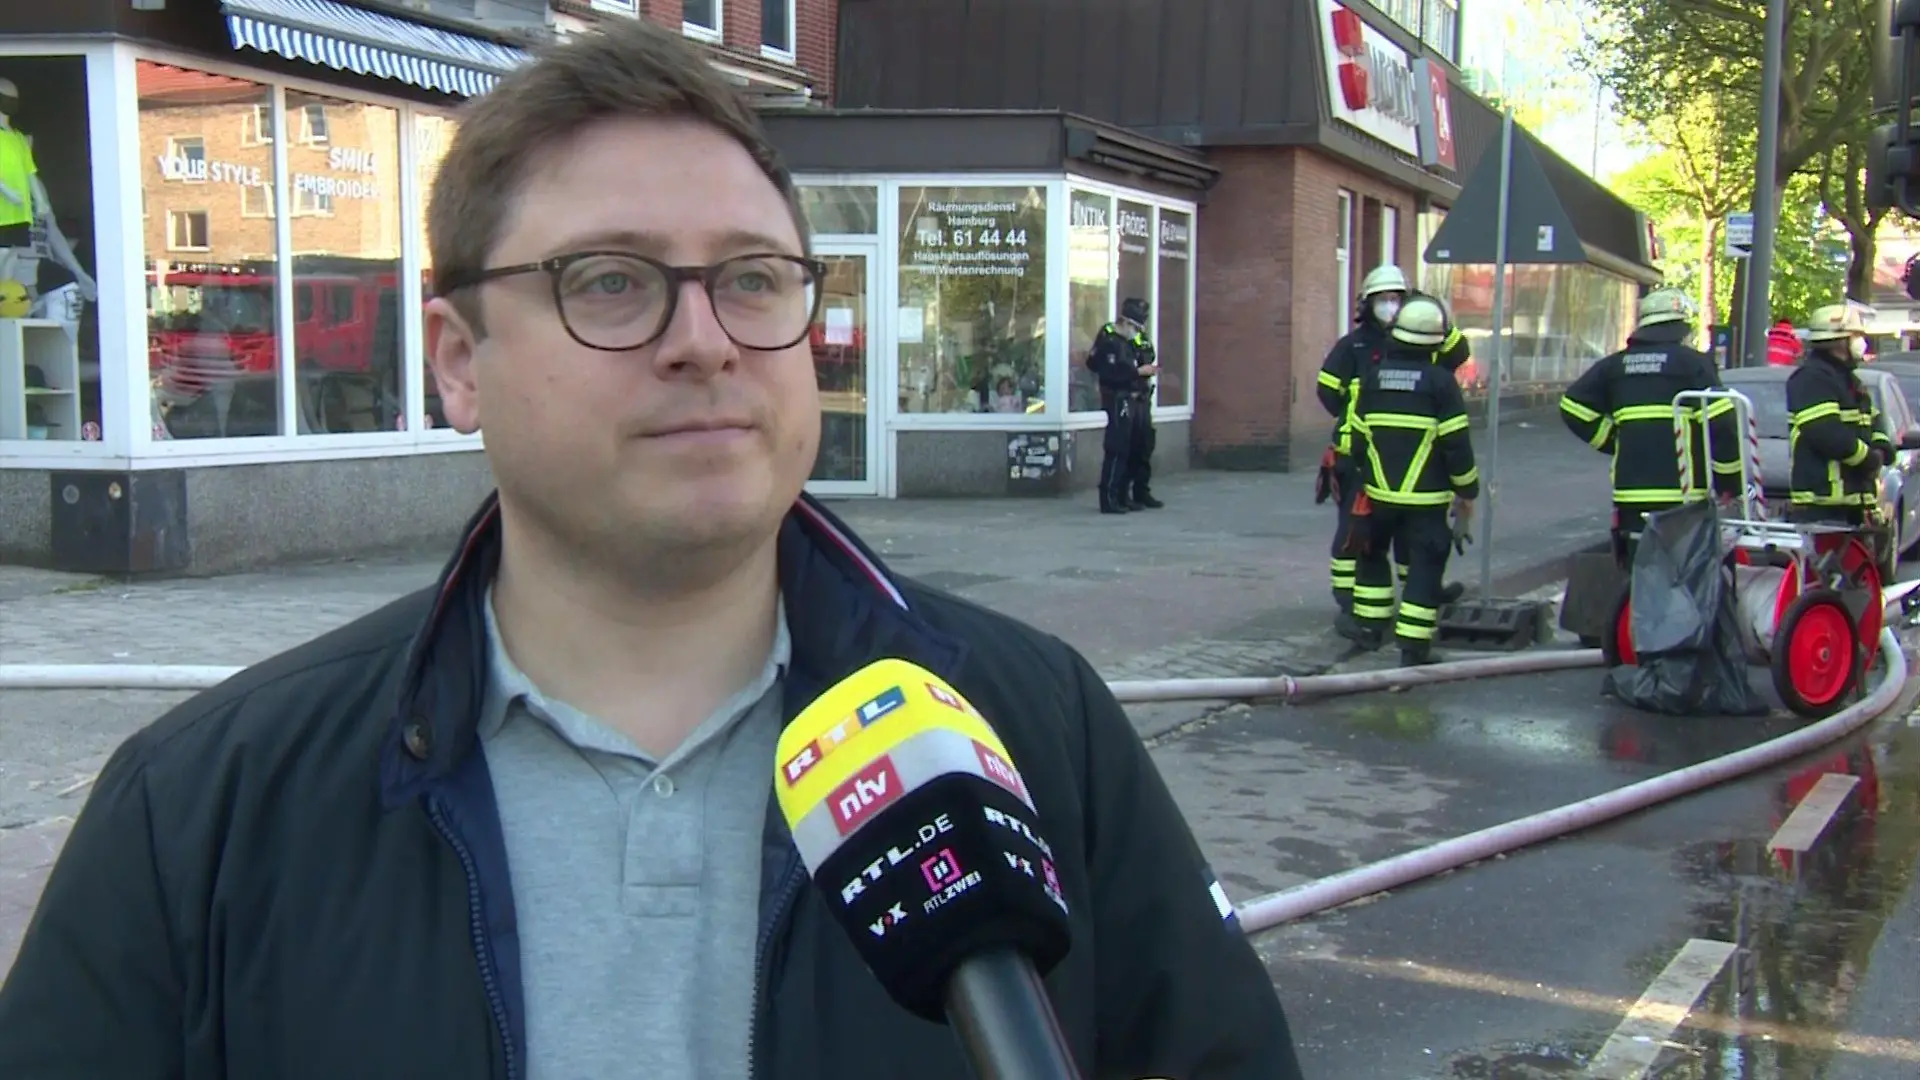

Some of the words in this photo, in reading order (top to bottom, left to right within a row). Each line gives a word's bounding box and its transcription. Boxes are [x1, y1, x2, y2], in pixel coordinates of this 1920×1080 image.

[157, 155, 208, 181] YOUR
[210, 160, 262, 187] STYLE
[928, 202, 1017, 215] Räumungsdienst
[947, 215, 996, 228] Hamburg
[918, 229, 948, 247] Tel.
[953, 229, 973, 247] 61
[979, 229, 1001, 247] 44
[1005, 229, 1028, 247] 44
[913, 251, 1030, 266] Haushaltsauflösungen
[1623, 353, 1669, 364] FEUERWEHR
[1377, 369, 1423, 380] FEUERWEHR
[1625, 363, 1662, 374] HAMBURG
[1379, 380, 1416, 390] HAMBURG
[784, 692, 902, 785] RTL
[838, 770, 887, 821] ntv
[840, 812, 955, 906] RTL.DE
[922, 869, 982, 915] RTLZWEI
